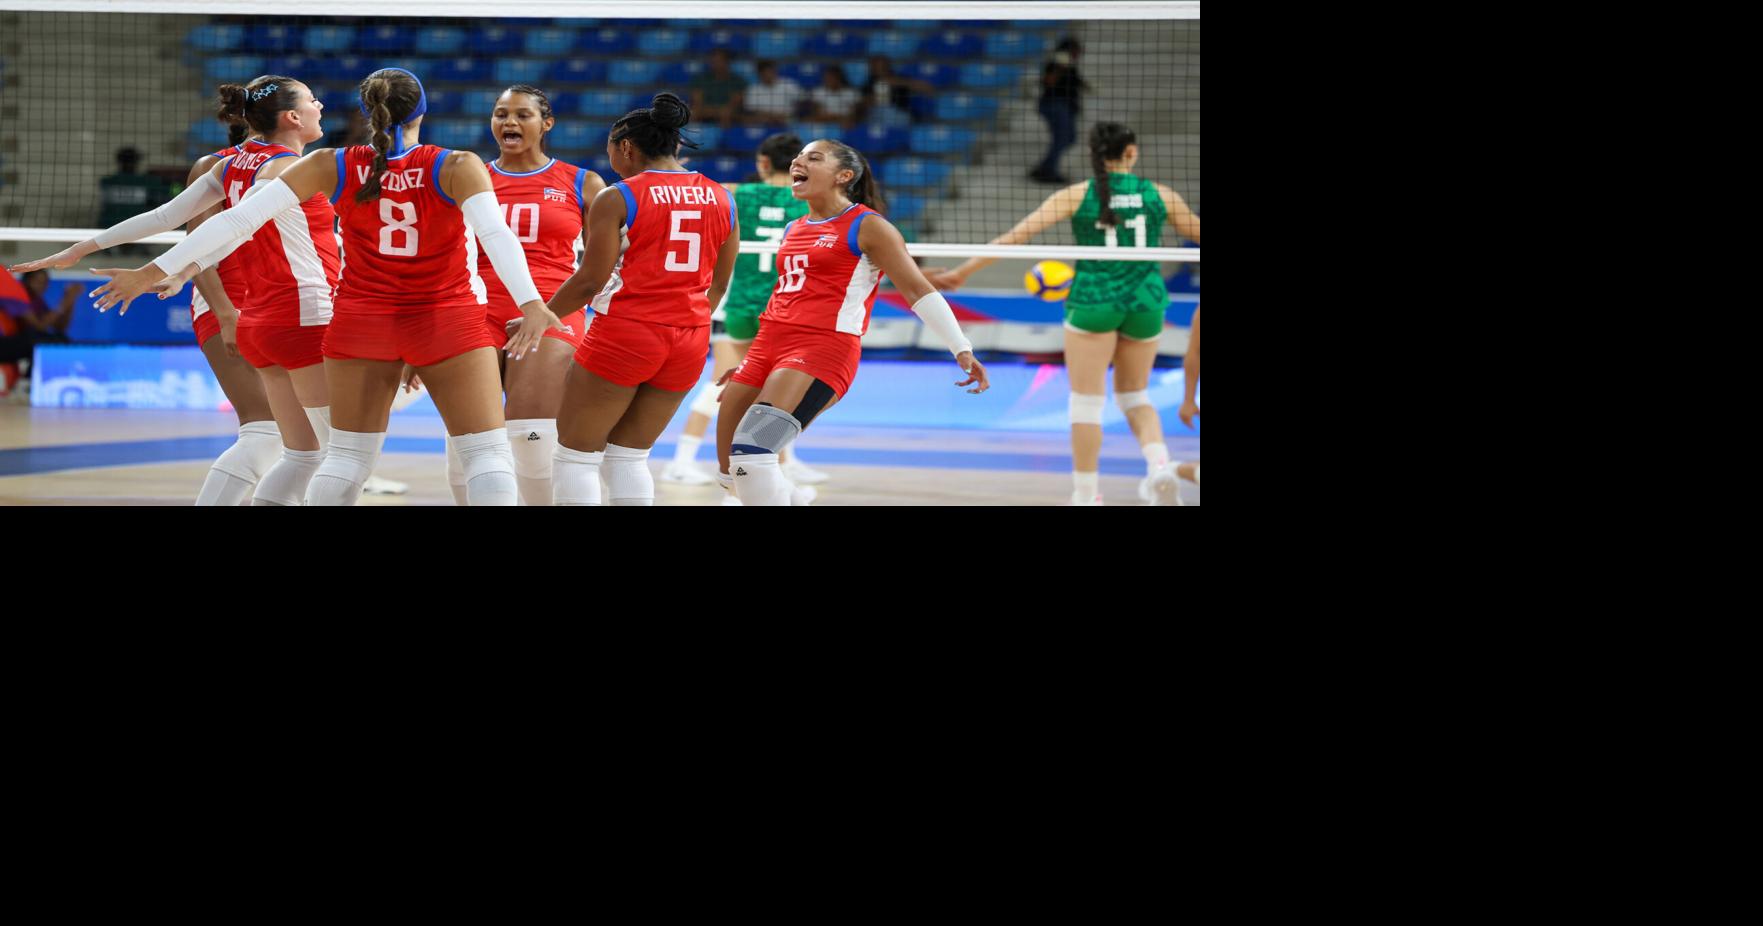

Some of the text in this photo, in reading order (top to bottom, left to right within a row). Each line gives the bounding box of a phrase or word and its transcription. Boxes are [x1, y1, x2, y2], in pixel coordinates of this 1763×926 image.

[356, 165, 424, 192] VZQUEZ
[649, 185, 718, 205] RIVERA
[379, 198, 419, 257] 8
[664, 210, 702, 272] 5
[776, 254, 809, 294] 16
